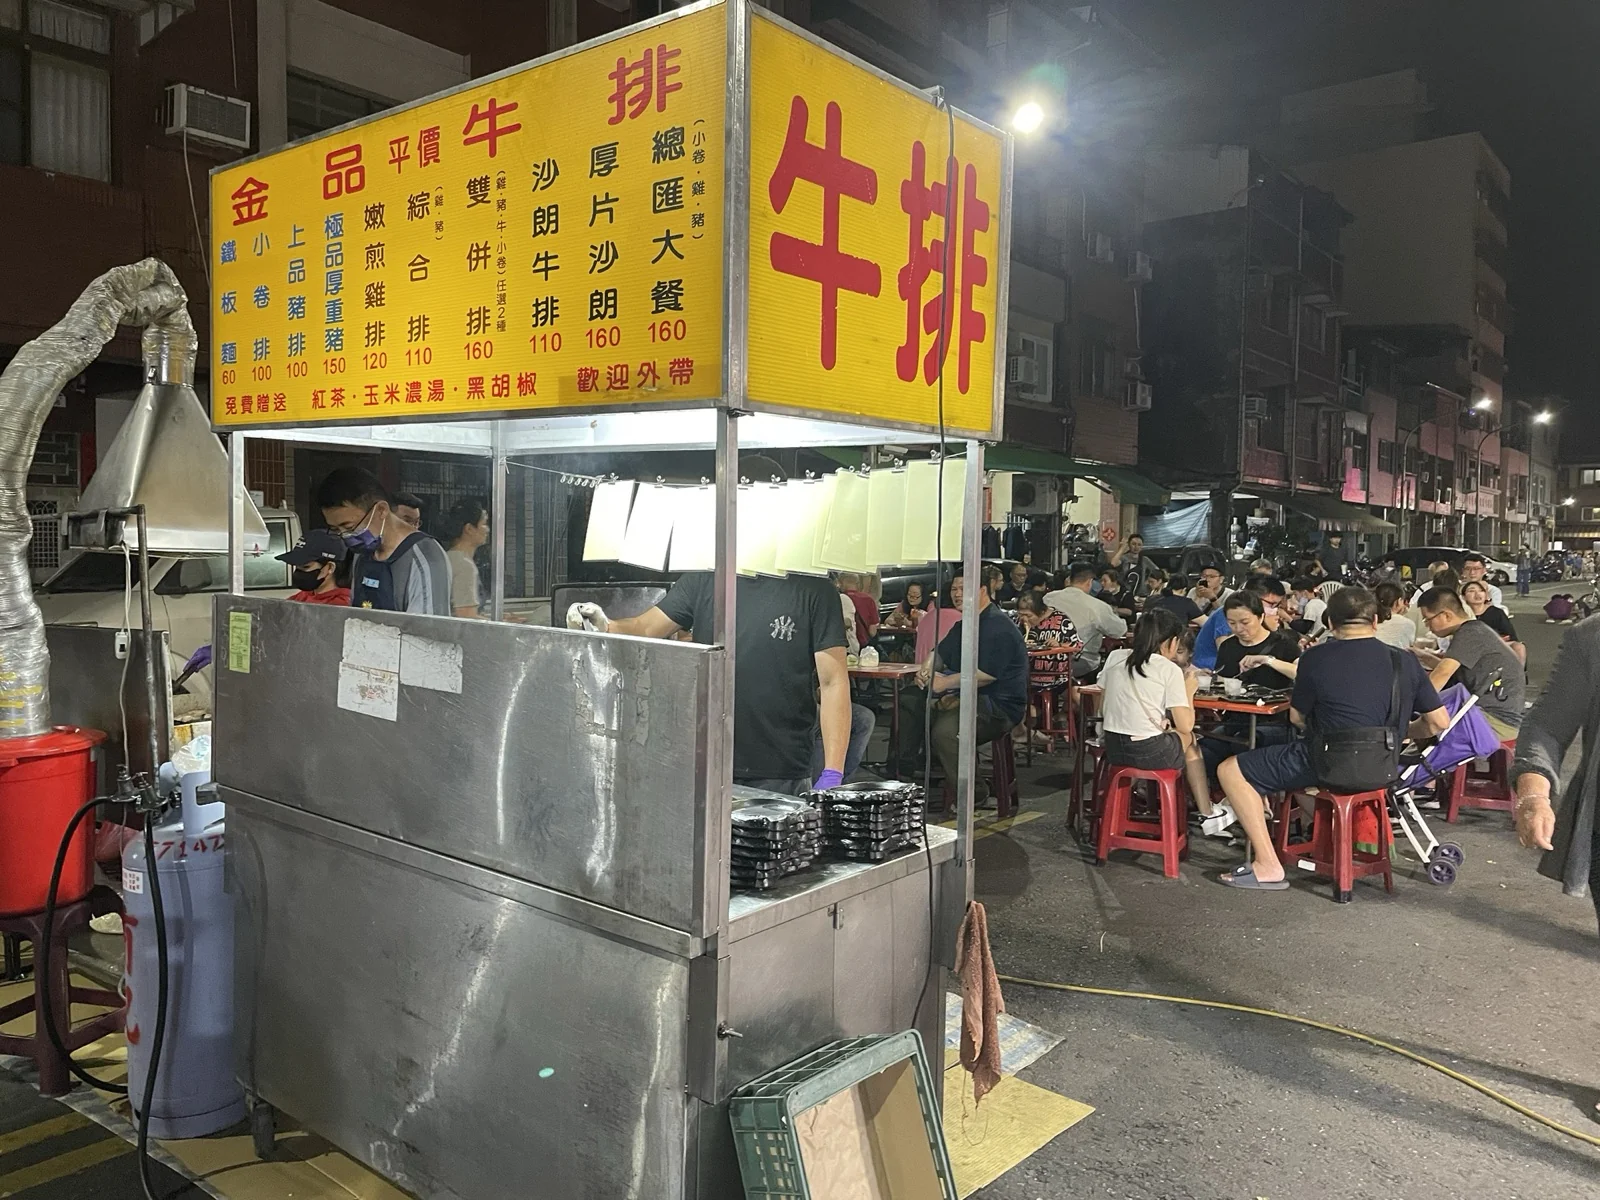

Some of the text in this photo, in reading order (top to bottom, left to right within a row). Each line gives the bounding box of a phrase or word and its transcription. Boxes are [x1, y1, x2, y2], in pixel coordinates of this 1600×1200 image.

[588, 142, 619, 321] 厚片沙朗
[651, 127, 685, 314] 總匯大餐
[466, 175, 491, 335] 雙併排
[532, 158, 560, 327] 沙朗牛排
[769, 95, 989, 394] 牛排
[325, 213, 344, 352] 極品厚重豬
[364, 202, 385, 347] 嫩煎雞排
[407, 191, 430, 342] 綜合排
[254, 233, 270, 361] 小卷排
[288, 224, 306, 357] 上品豬排
[464, 341, 493, 360] 160
[530, 333, 561, 353] 110
[586, 326, 620, 348] 160
[648, 319, 686, 342] 160
[252, 365, 271, 381] 100
[287, 361, 307, 378] 100
[324, 357, 345, 374] 150
[363, 352, 387, 370] 120
[406, 347, 432, 366] 110
[223, 370, 235, 384] 60
[225, 393, 286, 415] 免費贈送
[577, 357, 694, 393] 歡迎外帶
[1039, 629, 1062, 641] ROCK
